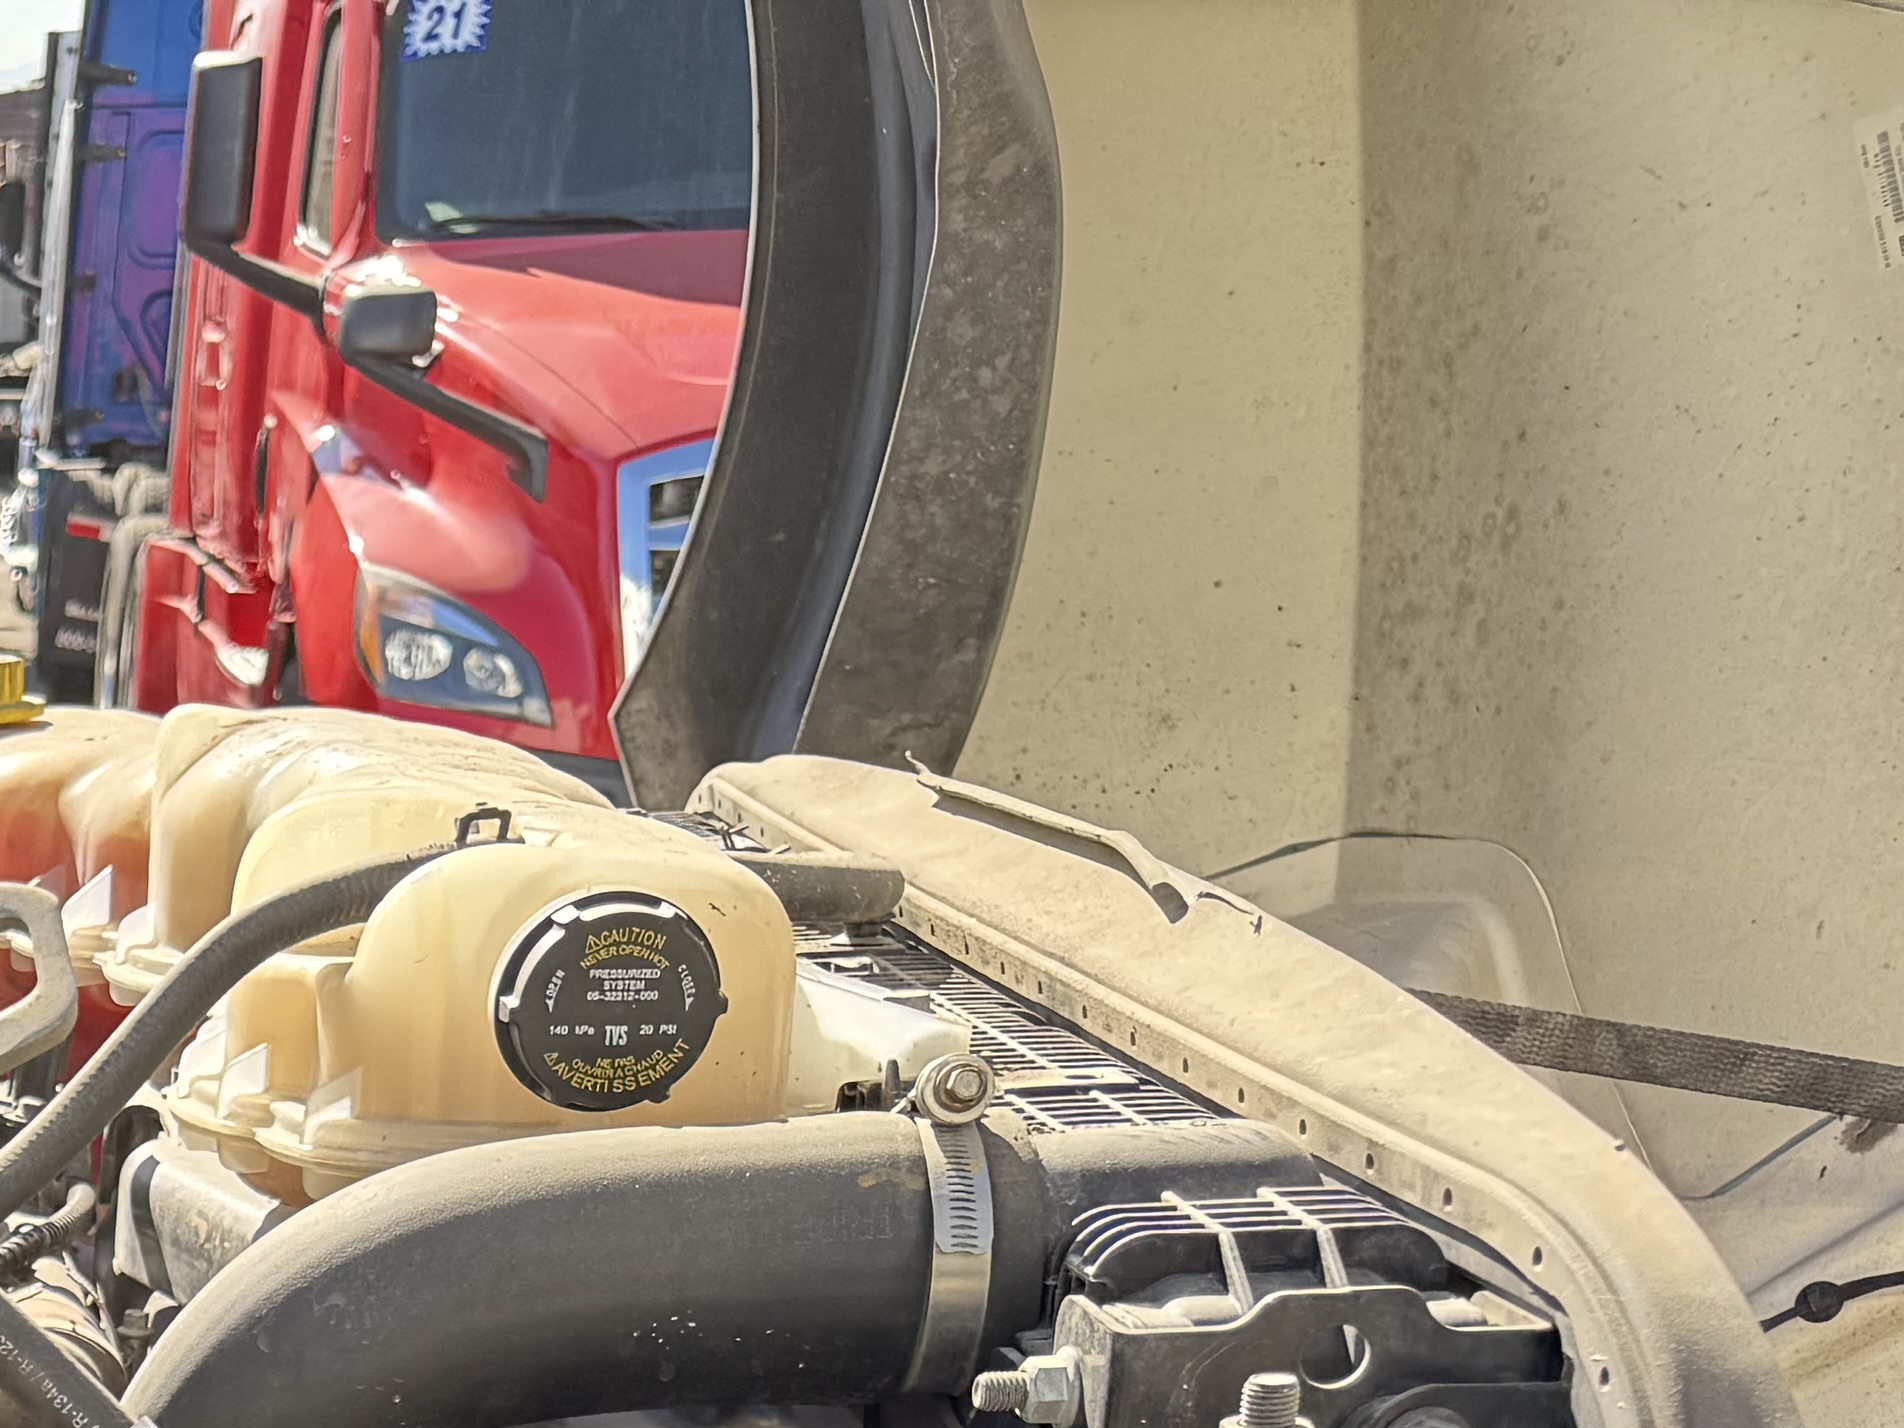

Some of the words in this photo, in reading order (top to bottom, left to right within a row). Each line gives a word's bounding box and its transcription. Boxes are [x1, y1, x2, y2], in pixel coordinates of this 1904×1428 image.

[421, 2, 468, 44] 21
[600, 926, 667, 950] CAUTION
[580, 946, 618, 970] NEVER
[618, 945, 650, 962] OPEN
[588, 968, 661, 980] PRESSURIZED
[602, 980, 646, 991] SYSTEM
[549, 1025, 569, 1036] 140
[604, 1025, 629, 1046] TVS
[639, 1024, 654, 1035] 20
[658, 1024, 678, 1035] PSI
